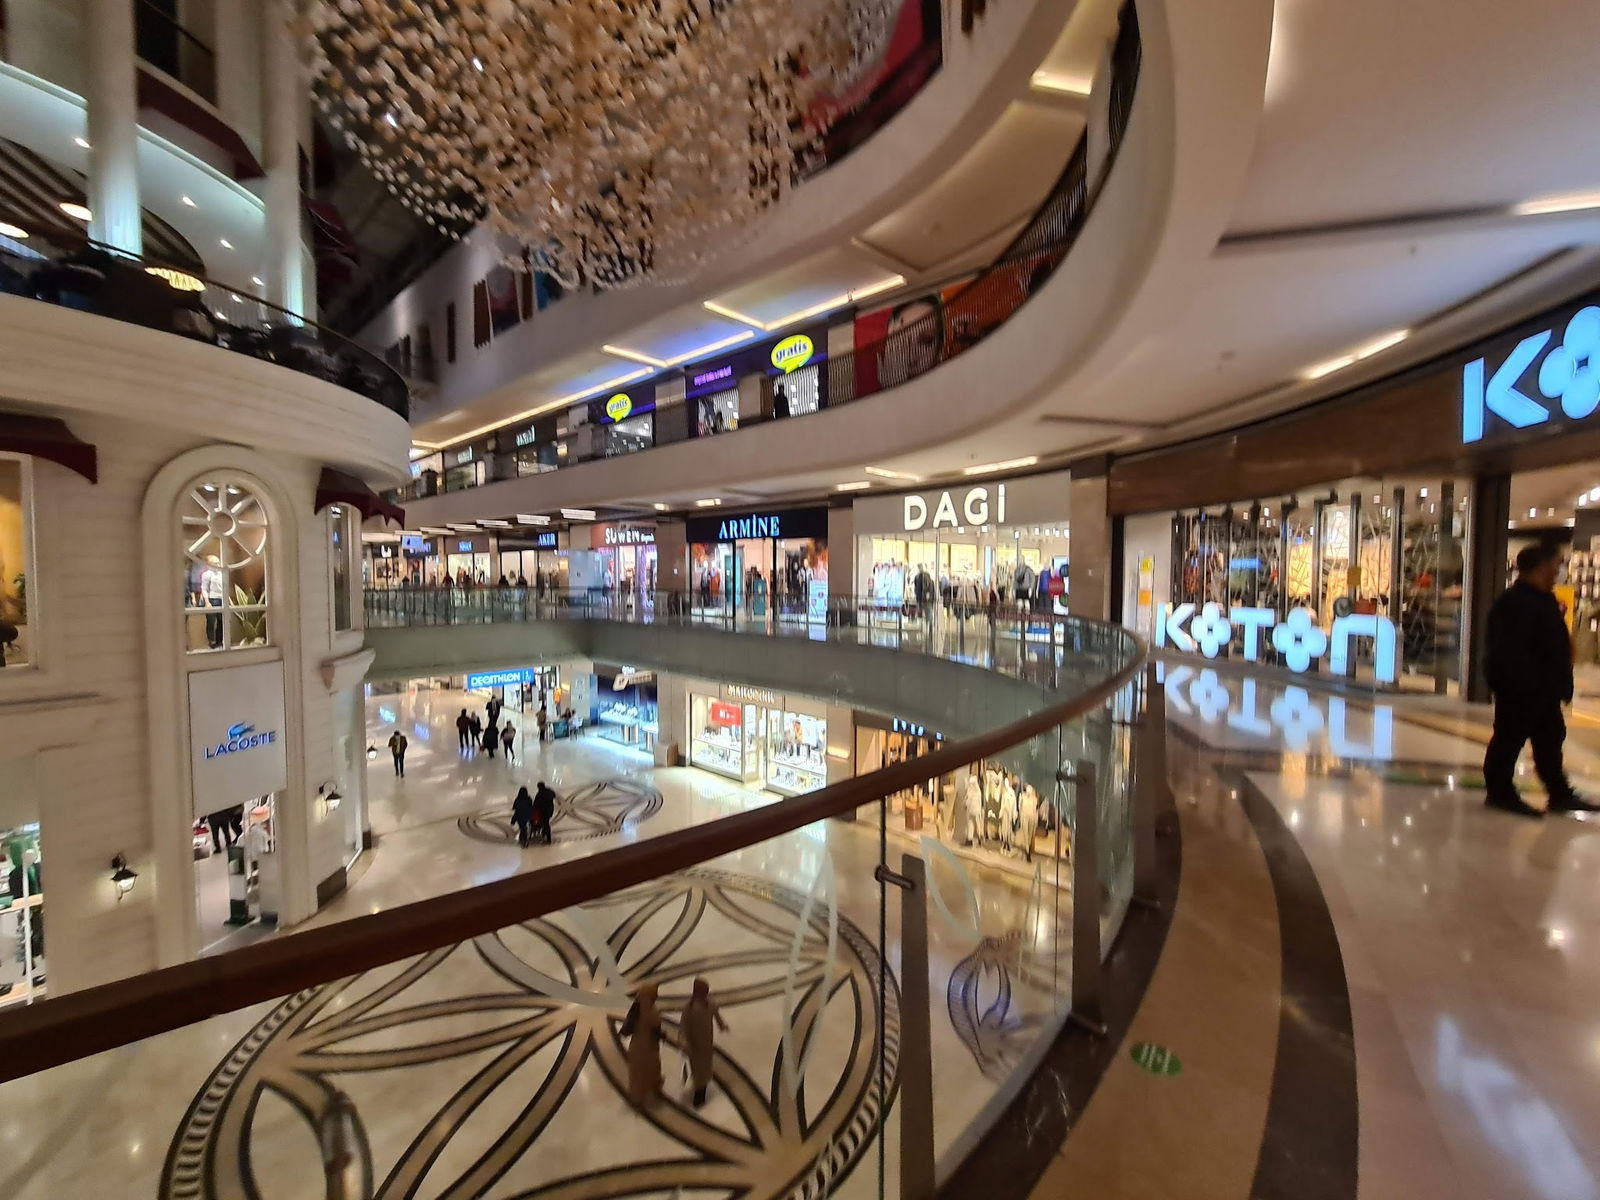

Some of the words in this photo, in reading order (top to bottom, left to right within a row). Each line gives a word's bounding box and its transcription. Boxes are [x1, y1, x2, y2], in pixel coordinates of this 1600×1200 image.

[776, 339, 808, 363] gratis
[719, 514, 780, 539] ARMİNE
[471, 671, 520, 686] DECATHLON
[204, 730, 277, 760] LACOSTE
